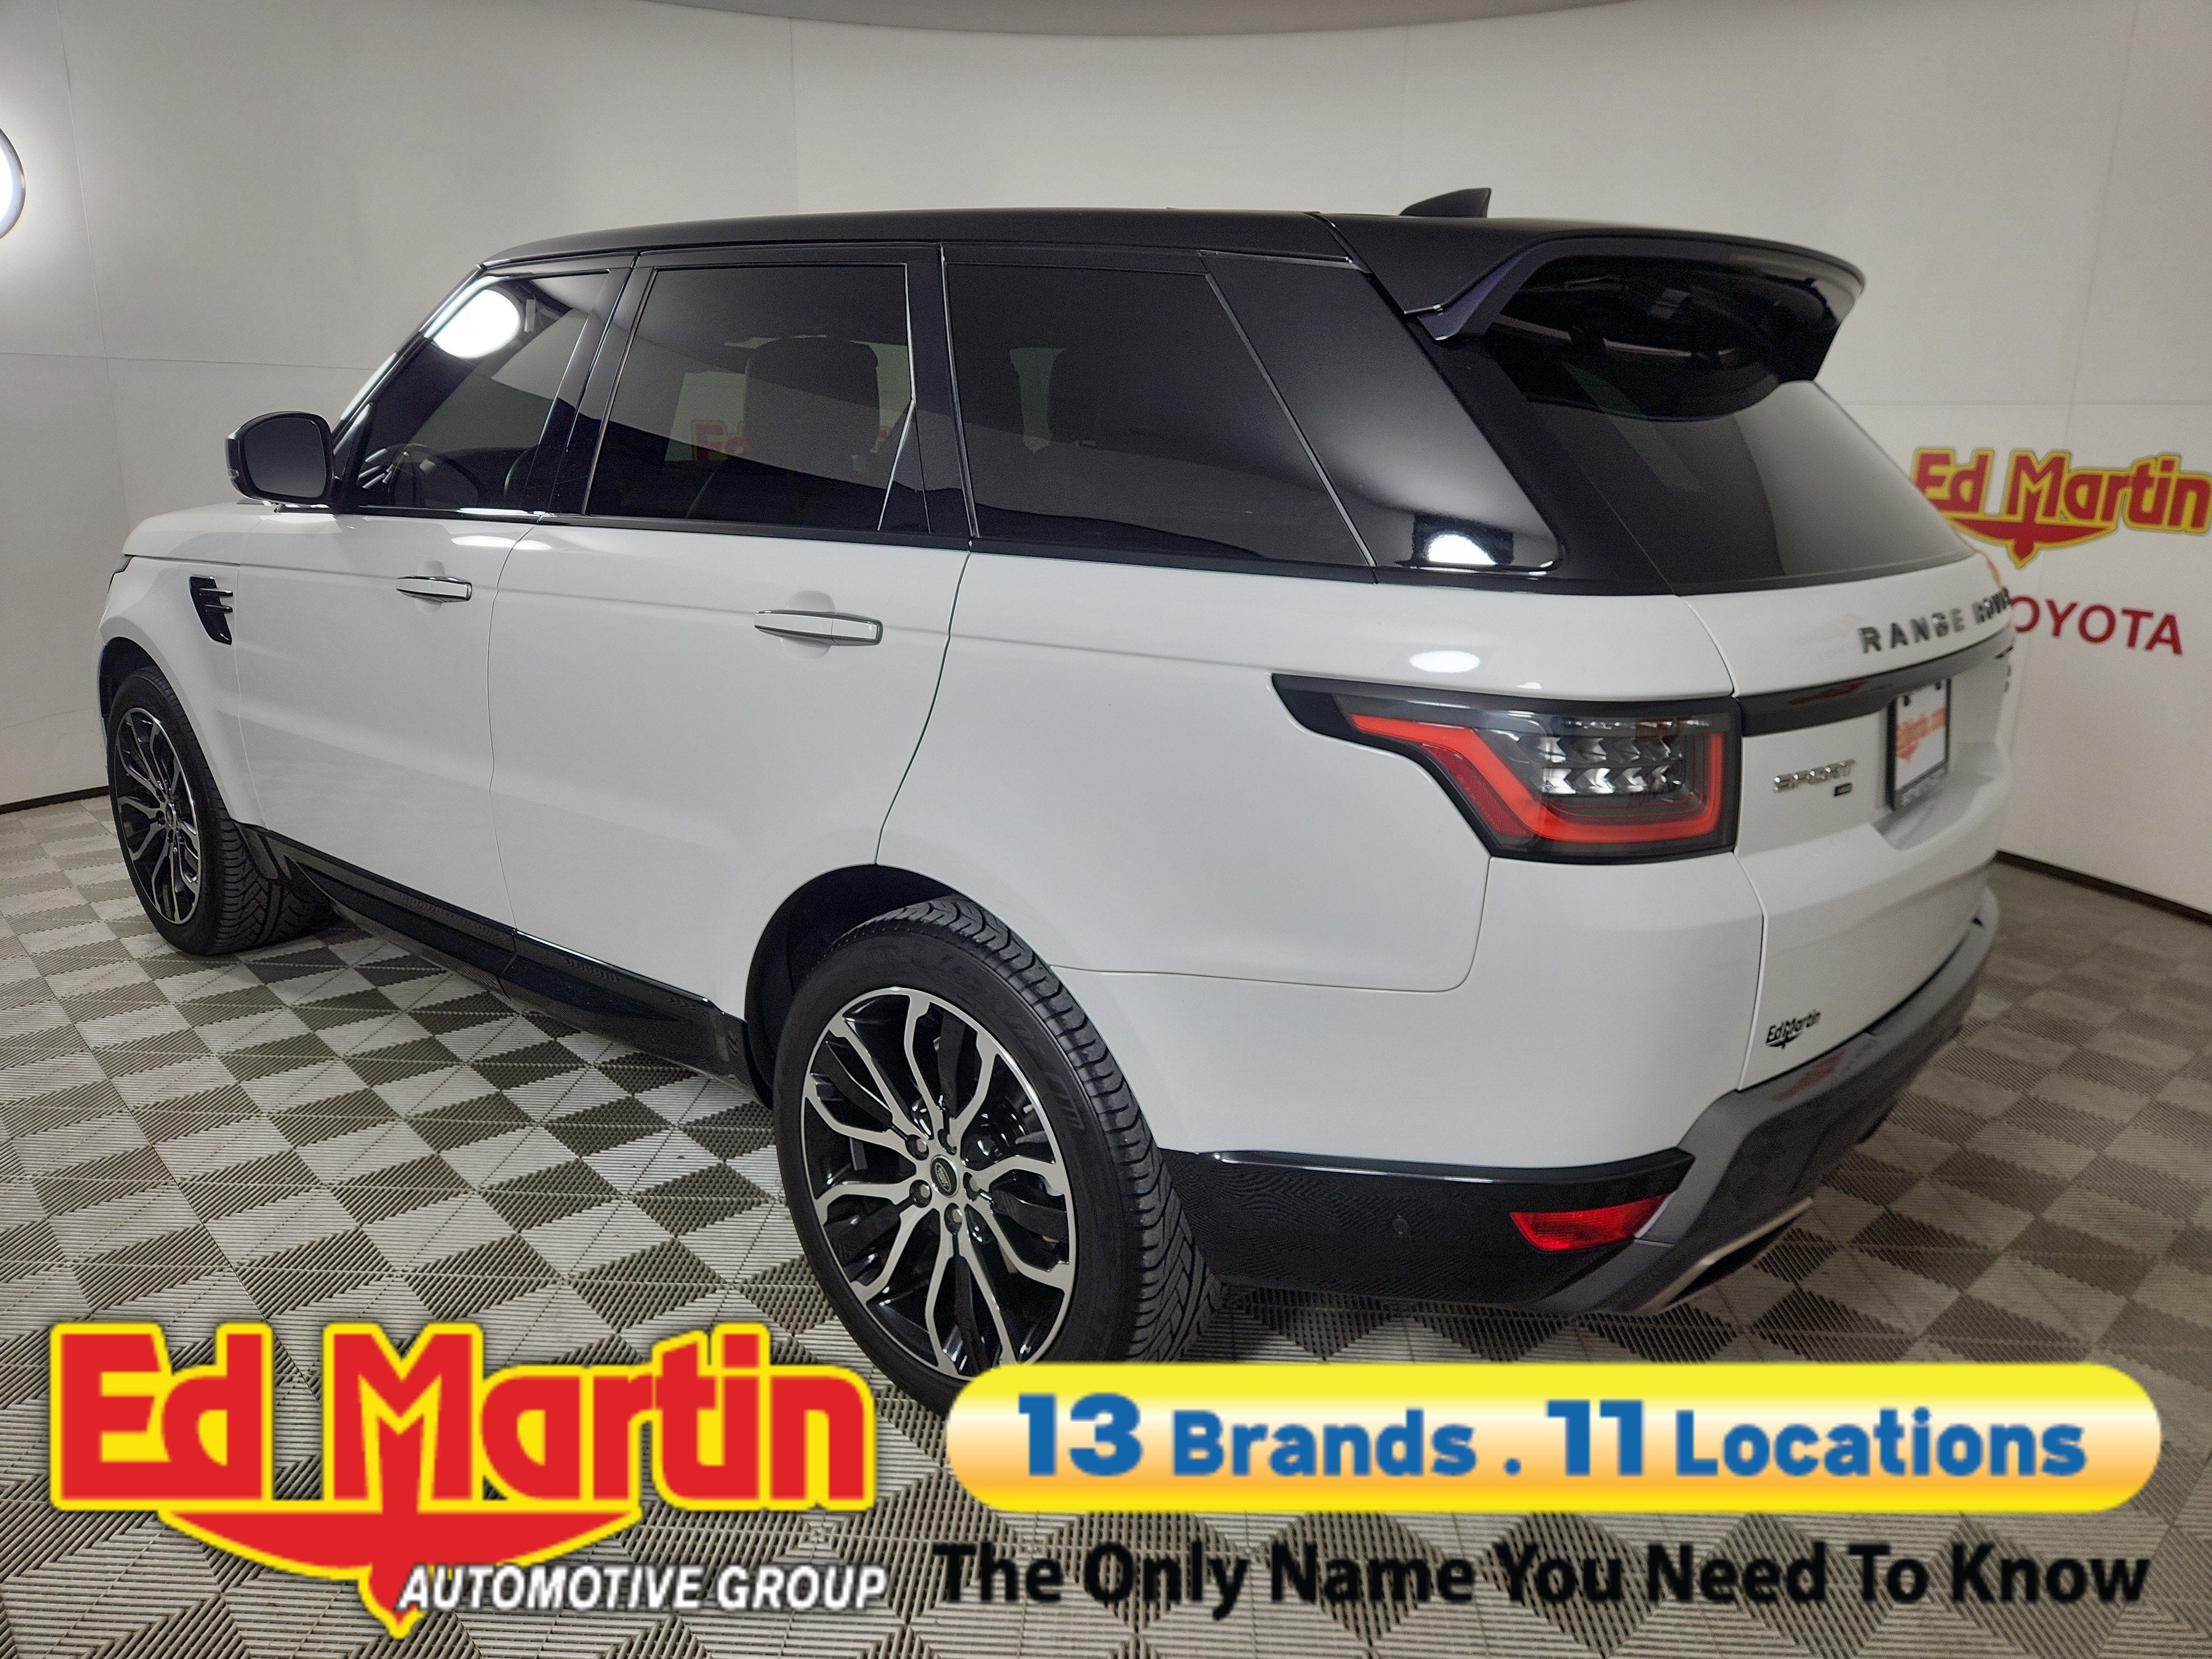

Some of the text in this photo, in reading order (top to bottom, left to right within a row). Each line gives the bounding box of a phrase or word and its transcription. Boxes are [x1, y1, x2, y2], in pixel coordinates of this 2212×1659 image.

[1912, 449, 2212, 533] Ed Martin
[1858, 608, 1965, 654] RANGE
[2009, 596, 2183, 656] OYOTA
